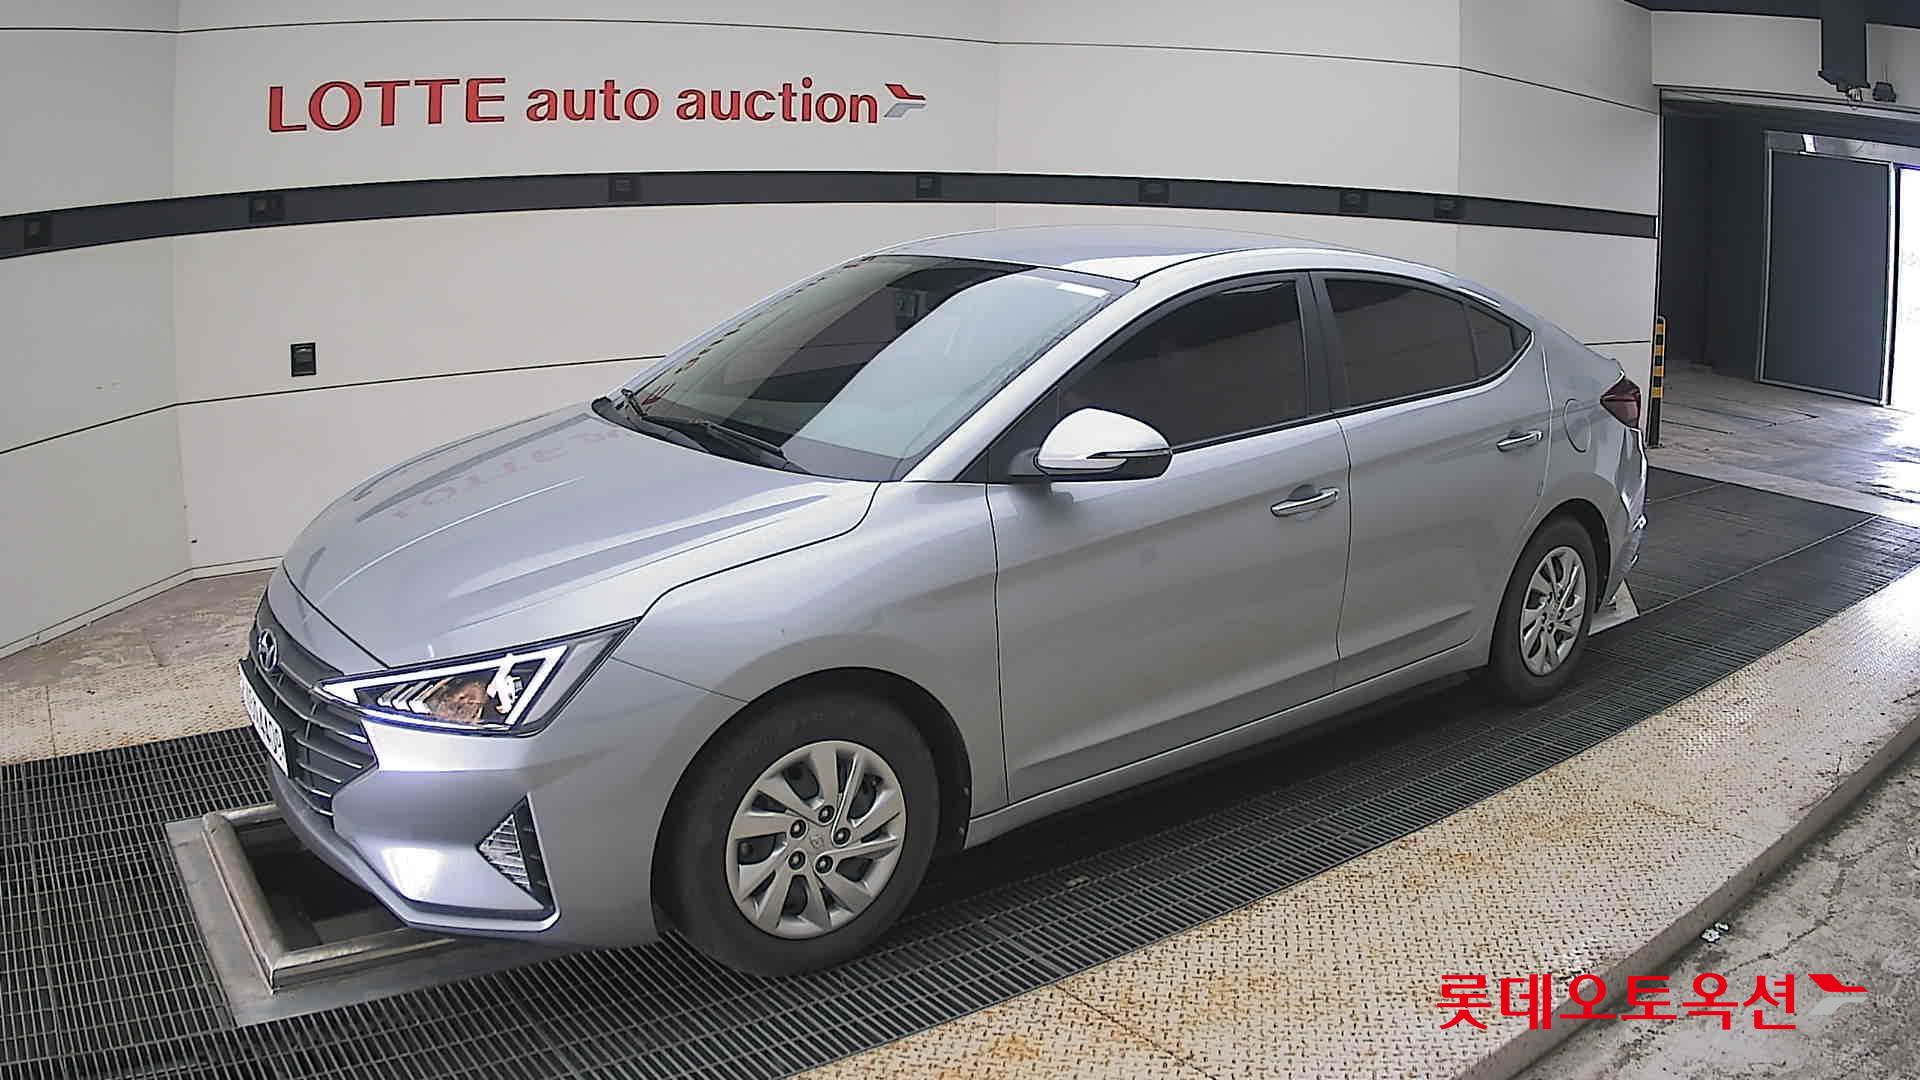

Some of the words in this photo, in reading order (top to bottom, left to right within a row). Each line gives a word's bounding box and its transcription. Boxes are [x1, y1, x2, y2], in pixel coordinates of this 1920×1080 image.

[268, 77, 506, 133] LOTTE
[526, 78, 660, 122] auto
[675, 76, 879, 125] auction
